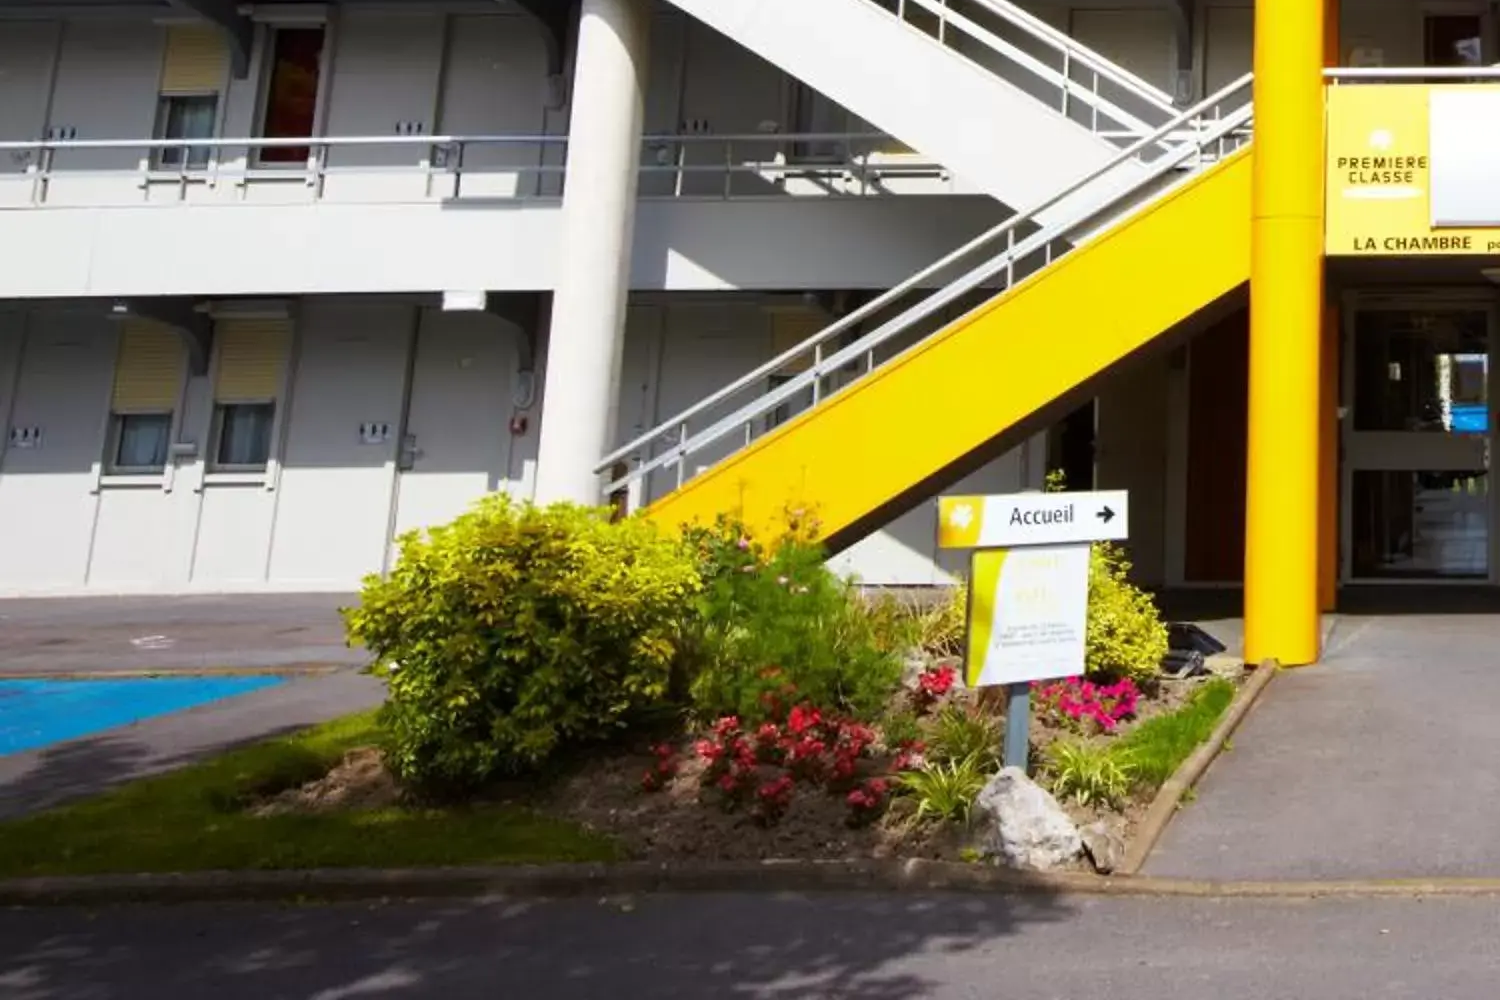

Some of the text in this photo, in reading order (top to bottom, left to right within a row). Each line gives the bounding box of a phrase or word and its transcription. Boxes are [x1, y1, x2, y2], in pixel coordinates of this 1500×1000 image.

[1337, 156, 1427, 170] PREMIERE
[1348, 171, 1414, 184] CLASSE
[1353, 236, 1377, 251] LA
[1383, 236, 1472, 251] CHAMBRE
[1009, 503, 1075, 526] Accueil
